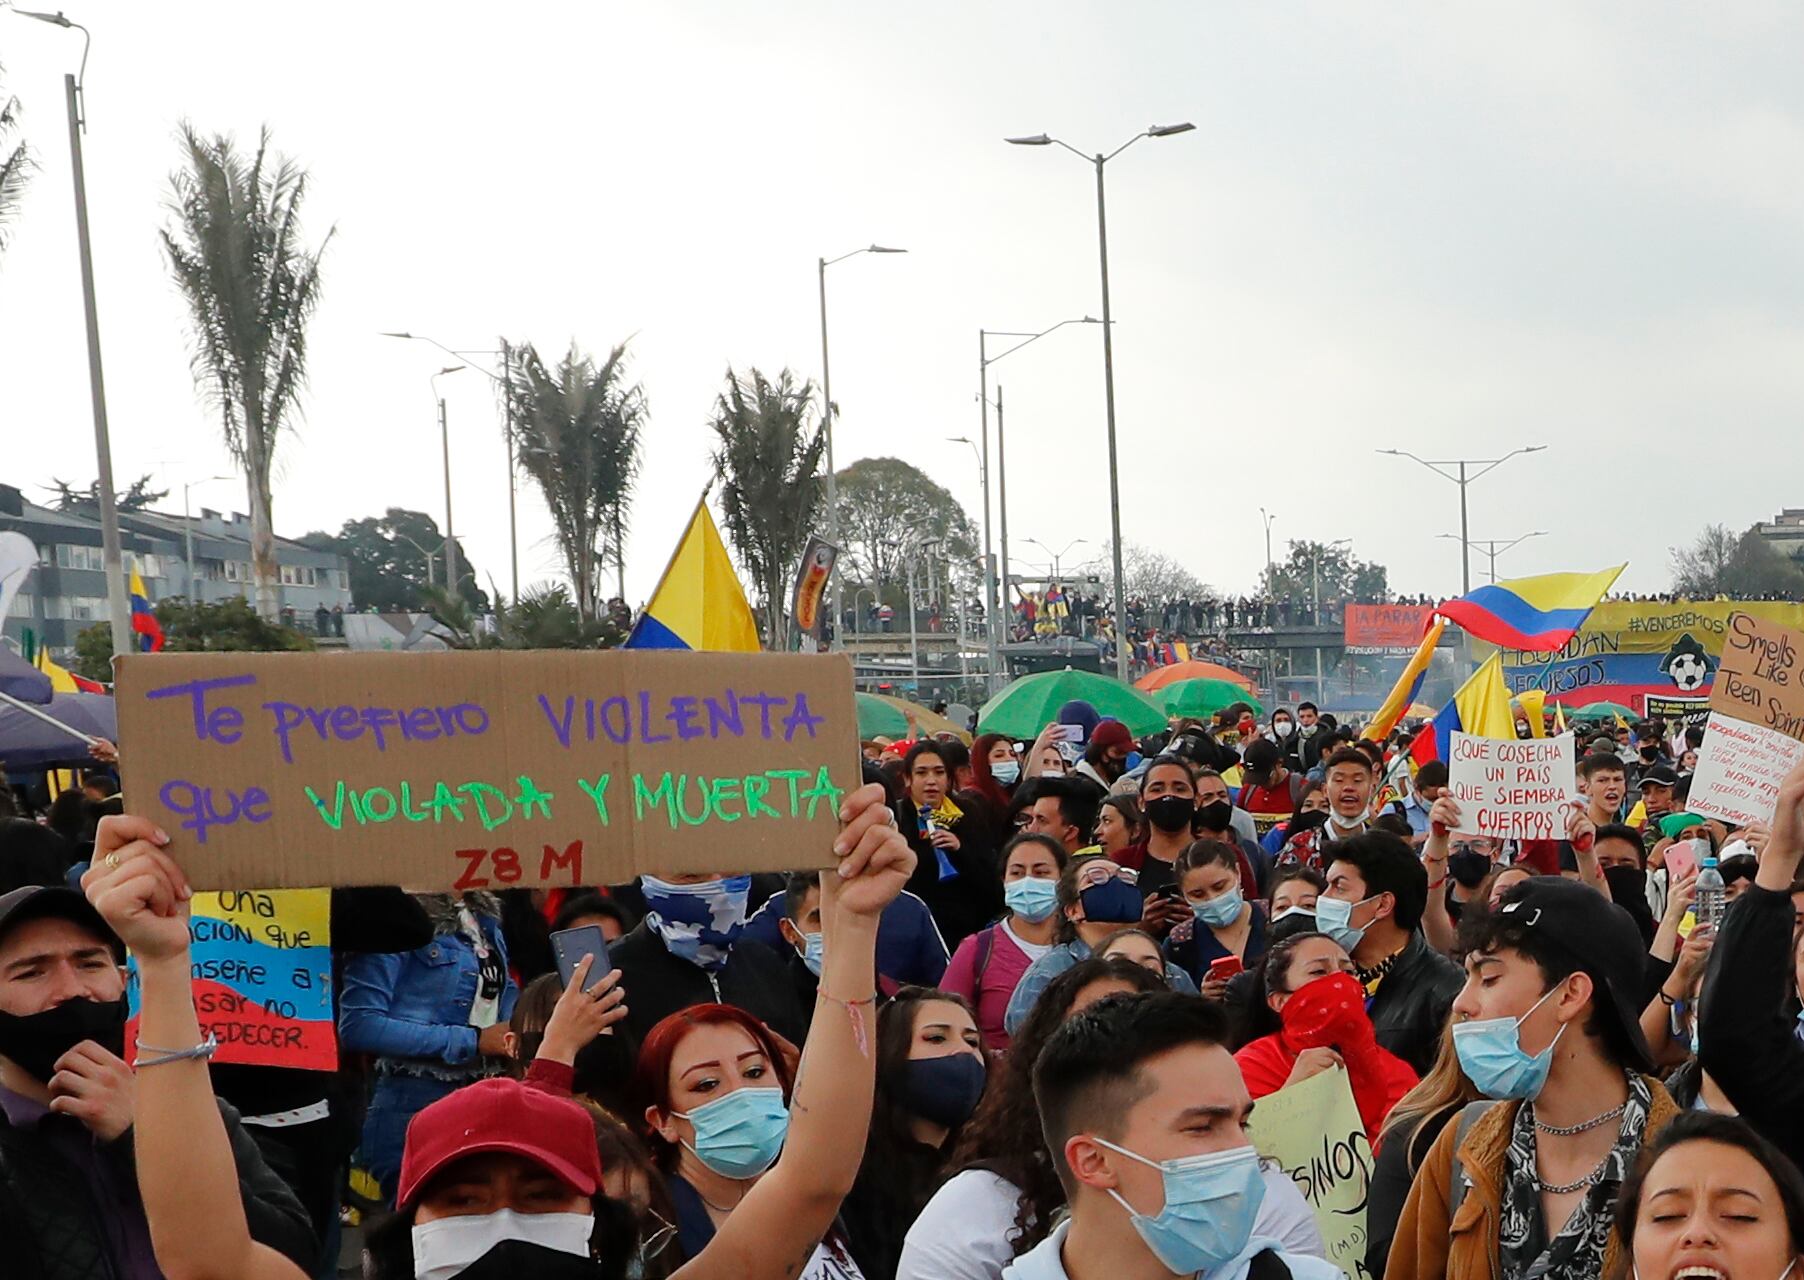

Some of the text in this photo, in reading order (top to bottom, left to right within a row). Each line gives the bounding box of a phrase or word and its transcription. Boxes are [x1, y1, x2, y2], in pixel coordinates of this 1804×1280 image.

[1628, 612, 1725, 634] #VENCEREMOS
[1730, 614, 1796, 668] Smells
[1753, 657, 1789, 687] Like
[1719, 668, 1761, 707] Teen
[146, 673, 257, 745] Te
[538, 688, 825, 749] VIOLENTA
[1454, 736, 1562, 764] ¿QUÉ COSECHA
[1485, 764, 1551, 785] UN PAÍS
[159, 764, 844, 844] que VIOLADA Y MUERTA
[1455, 781, 1566, 805] QUE SIEMBRA
[217, 890, 275, 917] Una
[265, 923, 314, 950] que
[292, 968, 312, 989] a
[264, 998, 297, 1019] no
